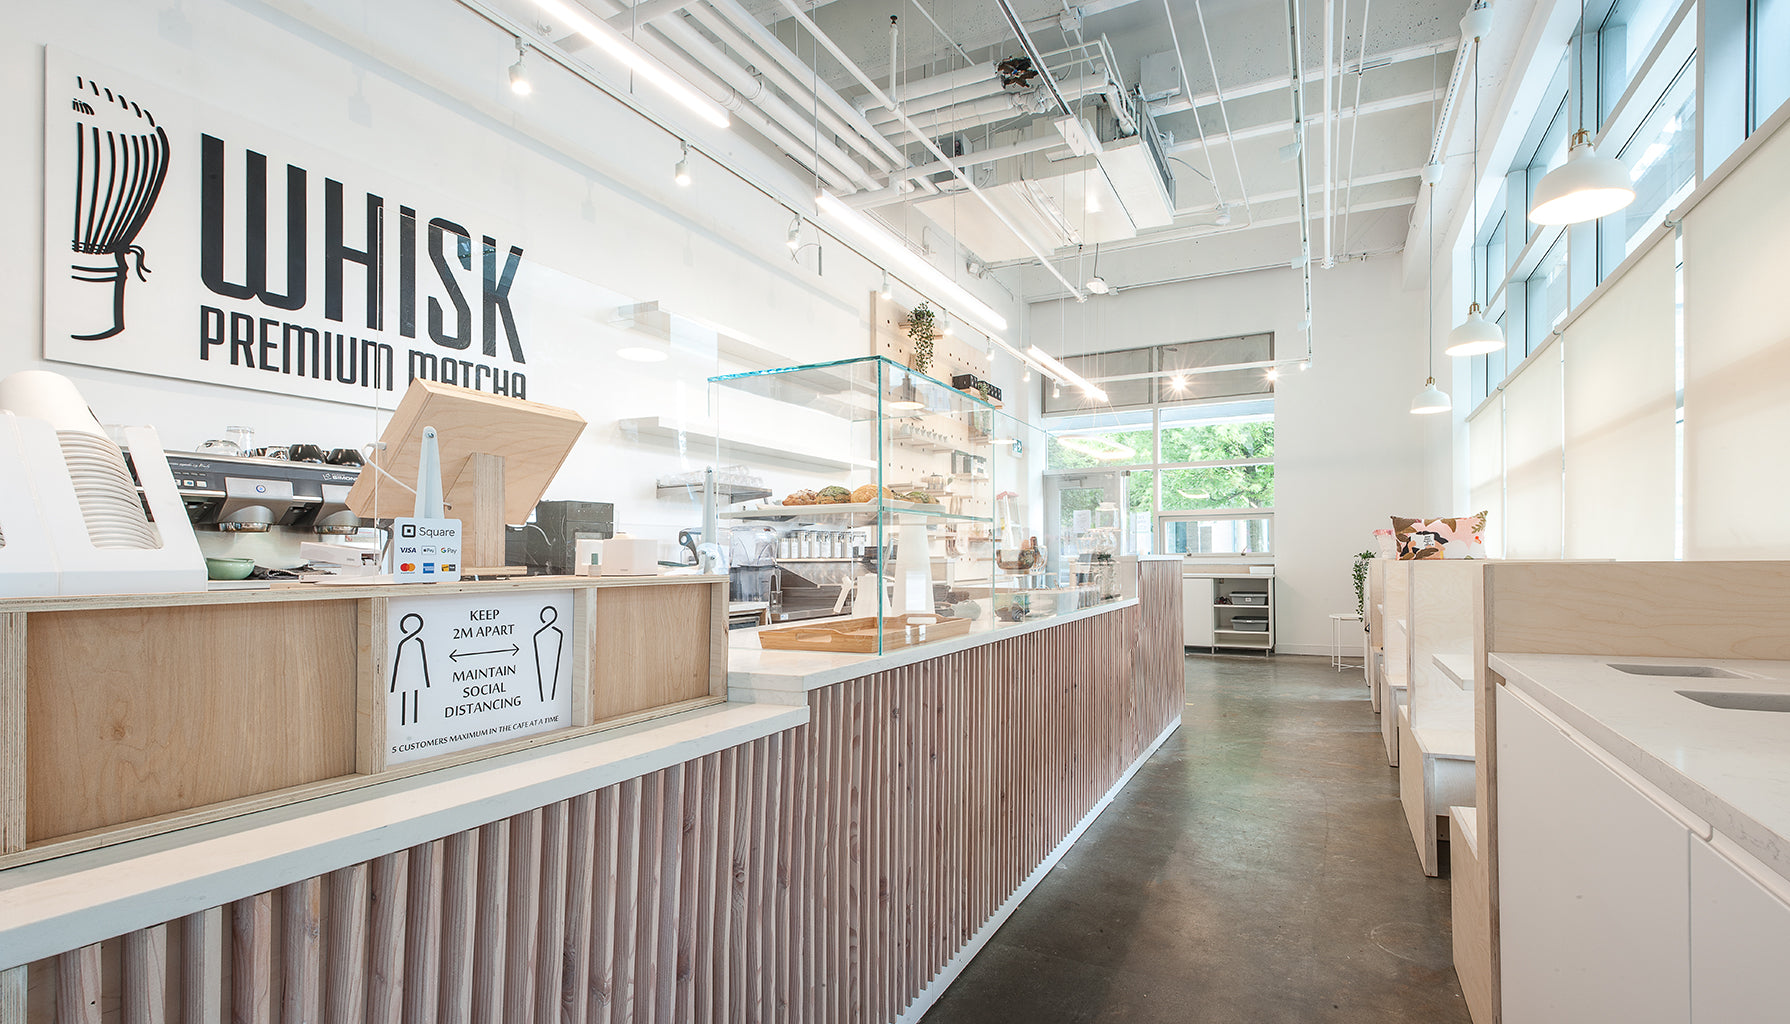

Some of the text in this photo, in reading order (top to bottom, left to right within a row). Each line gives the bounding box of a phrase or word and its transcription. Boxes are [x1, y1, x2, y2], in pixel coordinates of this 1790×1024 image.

[201, 133, 526, 364] WHISK
[200, 304, 527, 400] PREMIUM MATCHA
[419, 527, 456, 538] Square
[470, 610, 500, 621] KEEP
[453, 624, 515, 640] 2M APART
[453, 665, 516, 683] MAINTAIN
[462, 682, 506, 698] SOCIAL
[444, 695, 522, 718] DISTANCING
[391, 745, 397, 754] 5
[398, 736, 448, 753] CUSTOMERS
[449, 729, 488, 742] MAXIMUM
[489, 727, 497, 735] IN
[499, 724, 511, 733] THE
[512, 720, 528, 730] CAFE
[529, 719, 538, 727] AT
[544, 715, 559, 724] TIME
